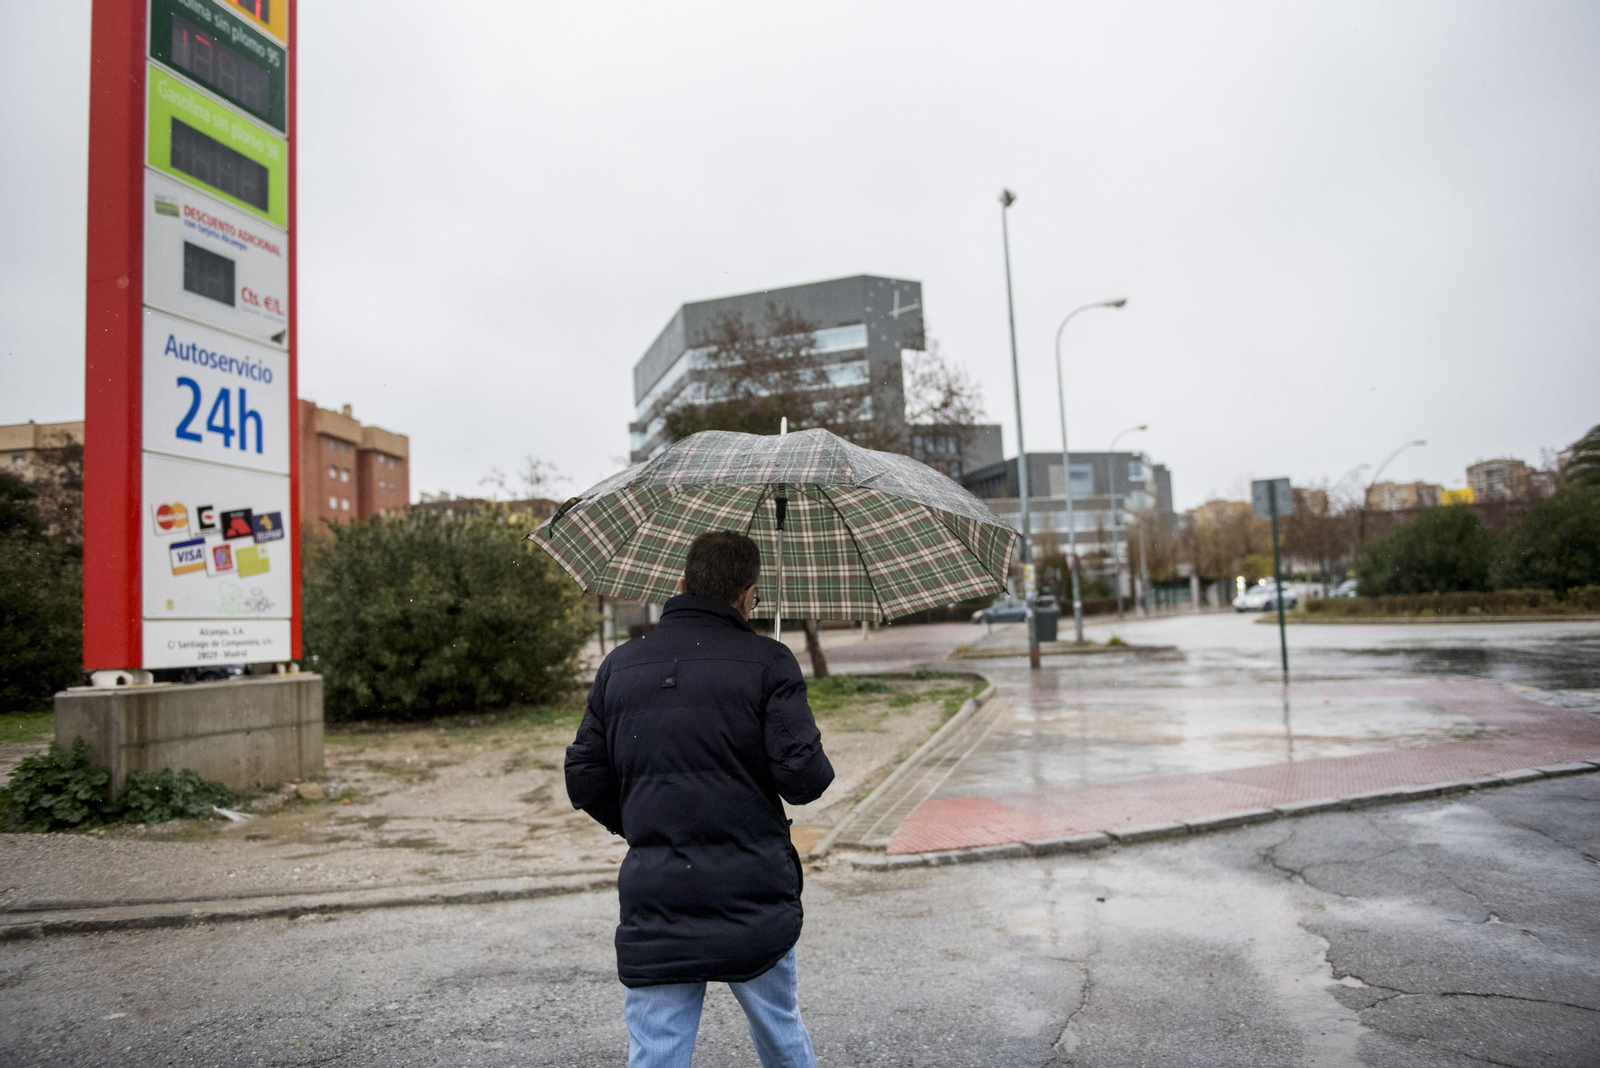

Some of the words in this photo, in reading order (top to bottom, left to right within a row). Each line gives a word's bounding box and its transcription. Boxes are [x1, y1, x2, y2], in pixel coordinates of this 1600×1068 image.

[213, 13, 230, 35] sin
[231, 25, 266, 58] plomo
[183, 203, 236, 237] DESCUENTO
[237, 228, 281, 257] ADICIONAL
[164, 333, 273, 384] Autoservicio
[175, 375, 263, 454] 24h
[177, 549, 203, 563] VISA
[178, 640, 209, 649] Santiago
[211, 639, 219, 647] de
